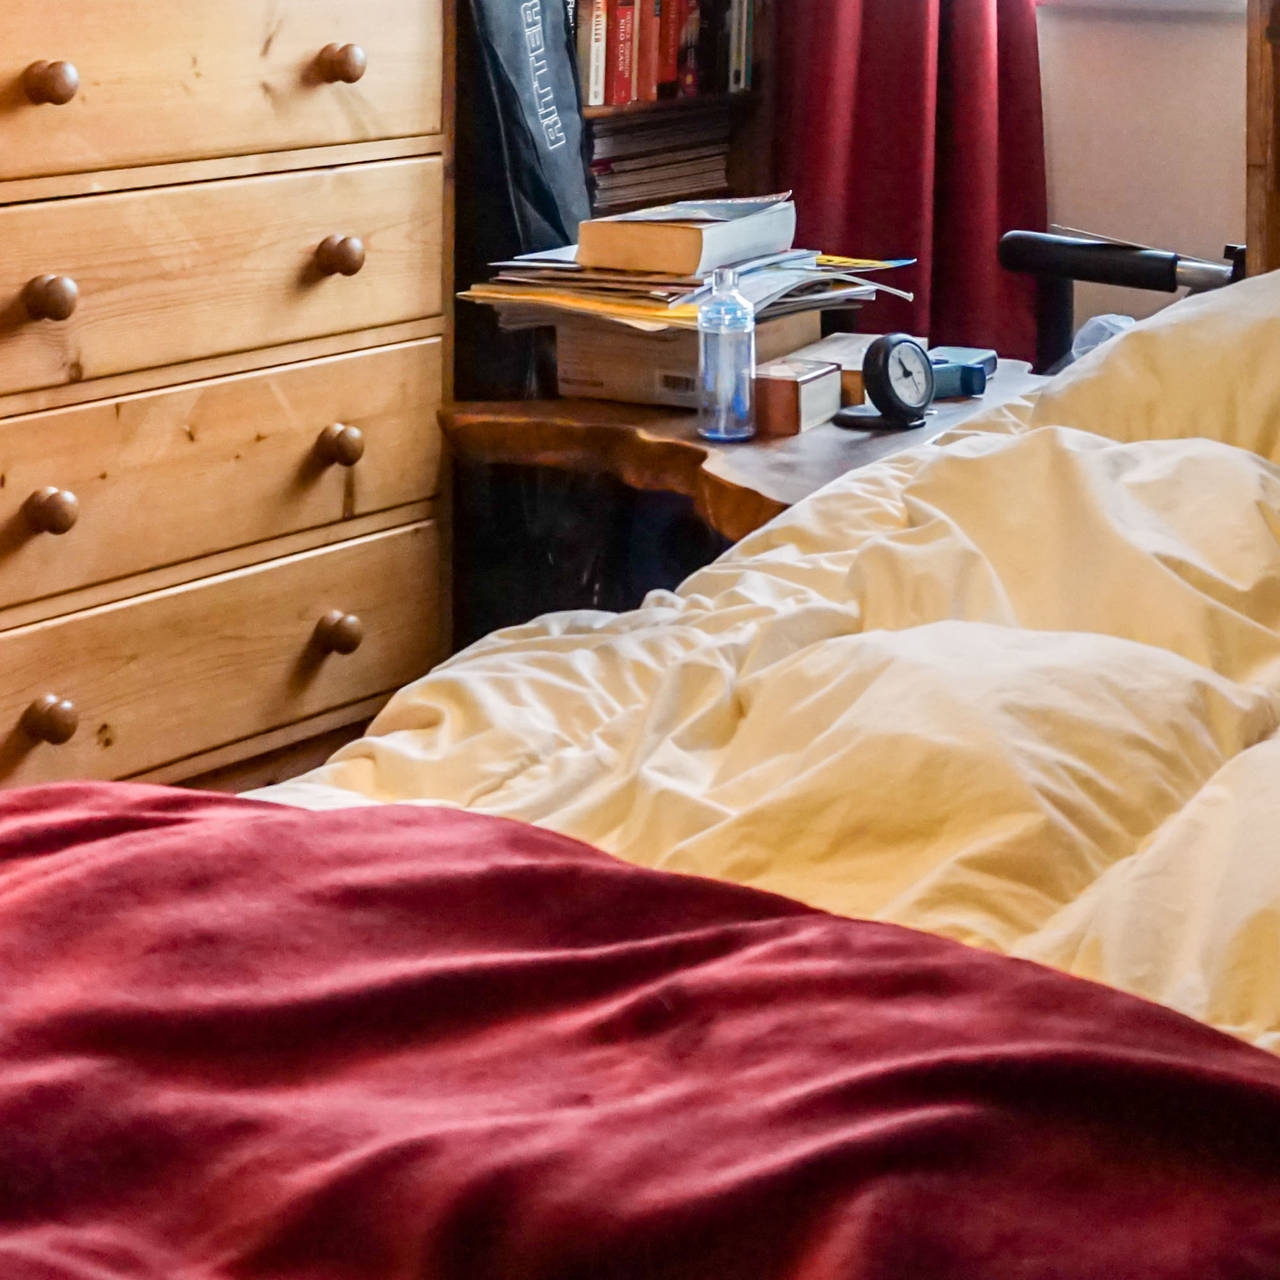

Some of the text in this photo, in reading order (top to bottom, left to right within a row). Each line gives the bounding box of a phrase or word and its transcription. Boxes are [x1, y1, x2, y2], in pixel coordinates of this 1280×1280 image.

[593, 14, 603, 43] KILLER
[617, 18, 626, 72] KILO CLASS
